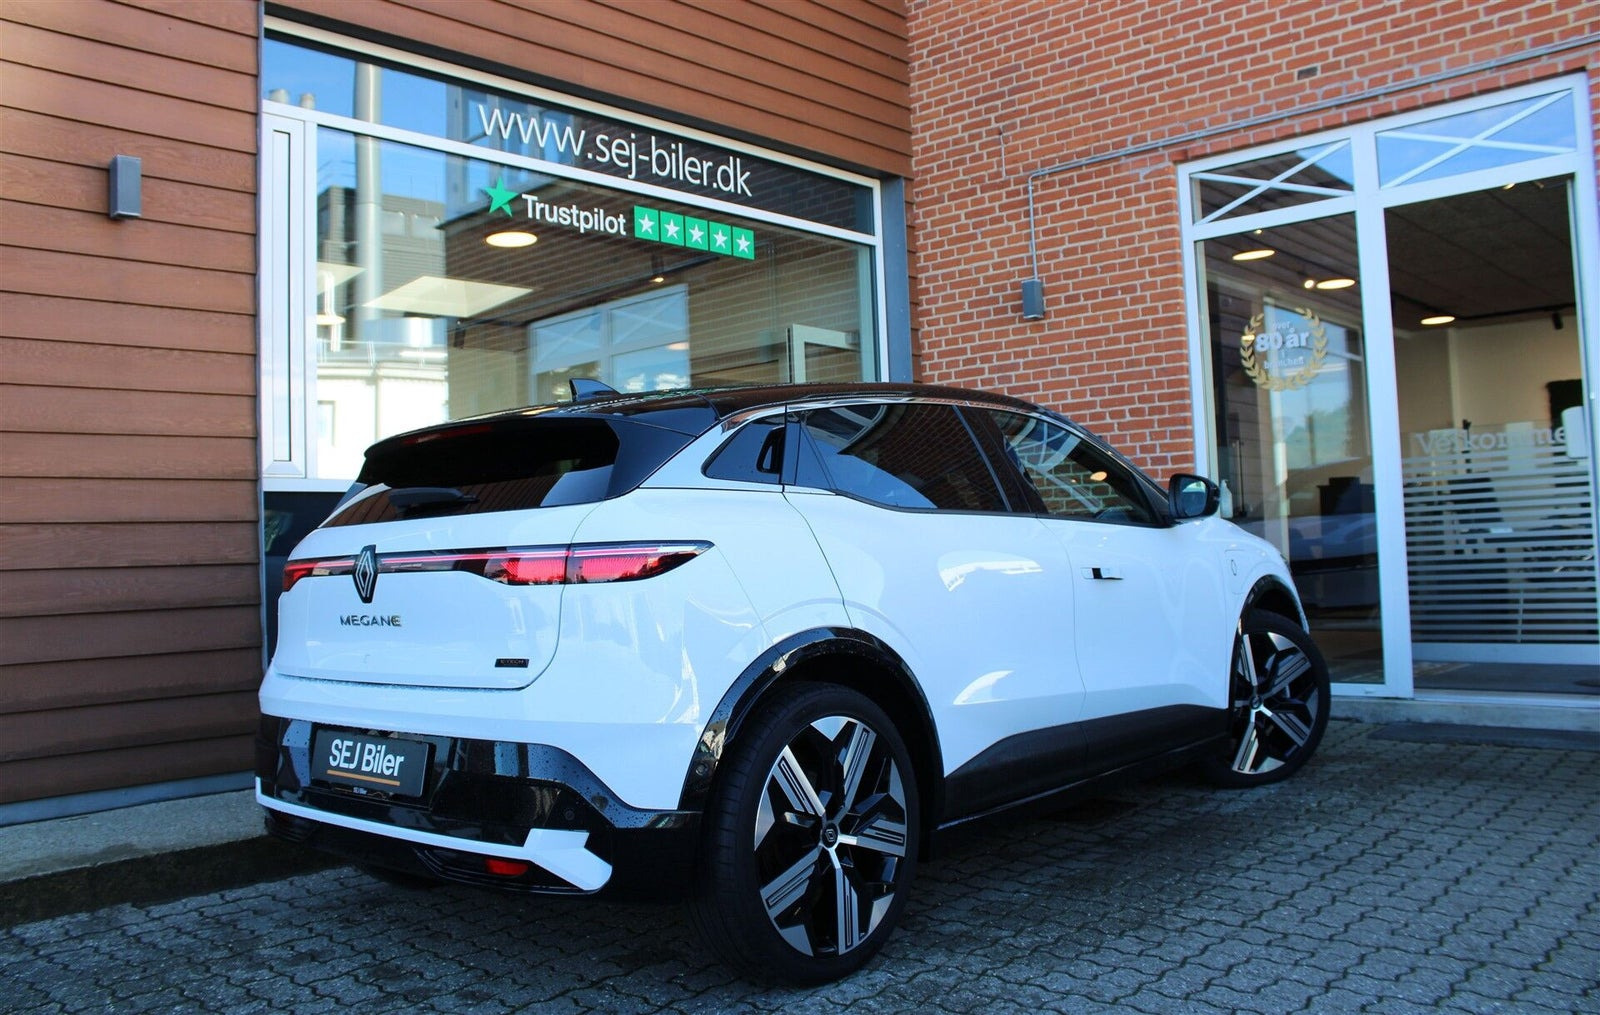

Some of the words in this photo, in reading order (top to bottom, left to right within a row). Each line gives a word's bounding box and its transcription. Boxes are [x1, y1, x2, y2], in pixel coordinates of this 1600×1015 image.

[479, 104, 752, 197] www.sej-biler.dk
[521, 193, 627, 236] Trustpilot
[1255, 332, 1283, 352] 80
[1285, 327, 1310, 348] år
[340, 615, 402, 627] MEGANE
[329, 738, 361, 770] SEJ
[361, 743, 405, 777] Biler
